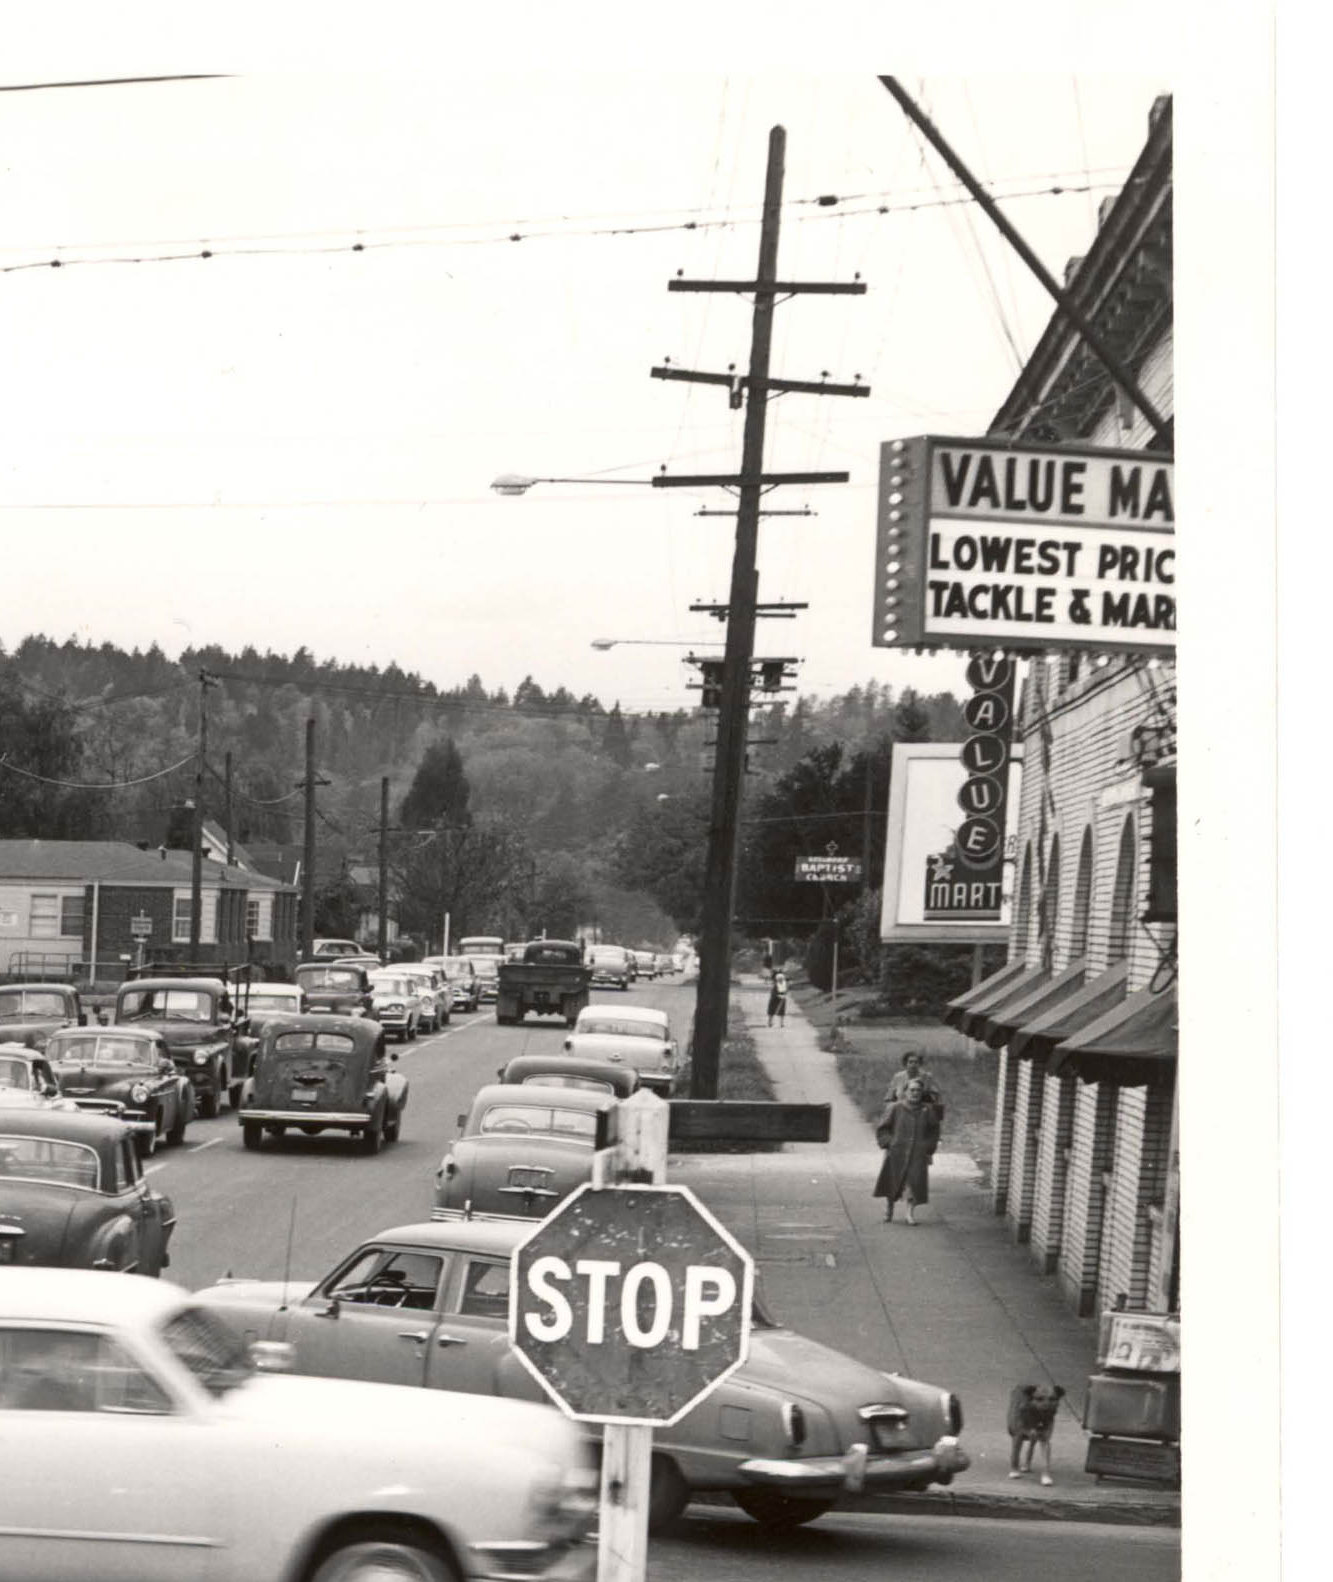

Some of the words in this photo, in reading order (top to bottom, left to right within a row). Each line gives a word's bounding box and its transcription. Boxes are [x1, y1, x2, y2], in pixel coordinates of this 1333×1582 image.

[940, 452, 1087, 515] VALUE
[930, 533, 1082, 577] LOWEST
[929, 580, 1057, 622] TACKLE
[1068, 588, 1092, 625] &
[1102, 591, 1177, 630] MAR
[966, 656, 1000, 850] VALUE
[801, 863, 854, 874] BAPTIST
[930, 882, 1002, 908] MART
[524, 1255, 736, 1351] STOP
